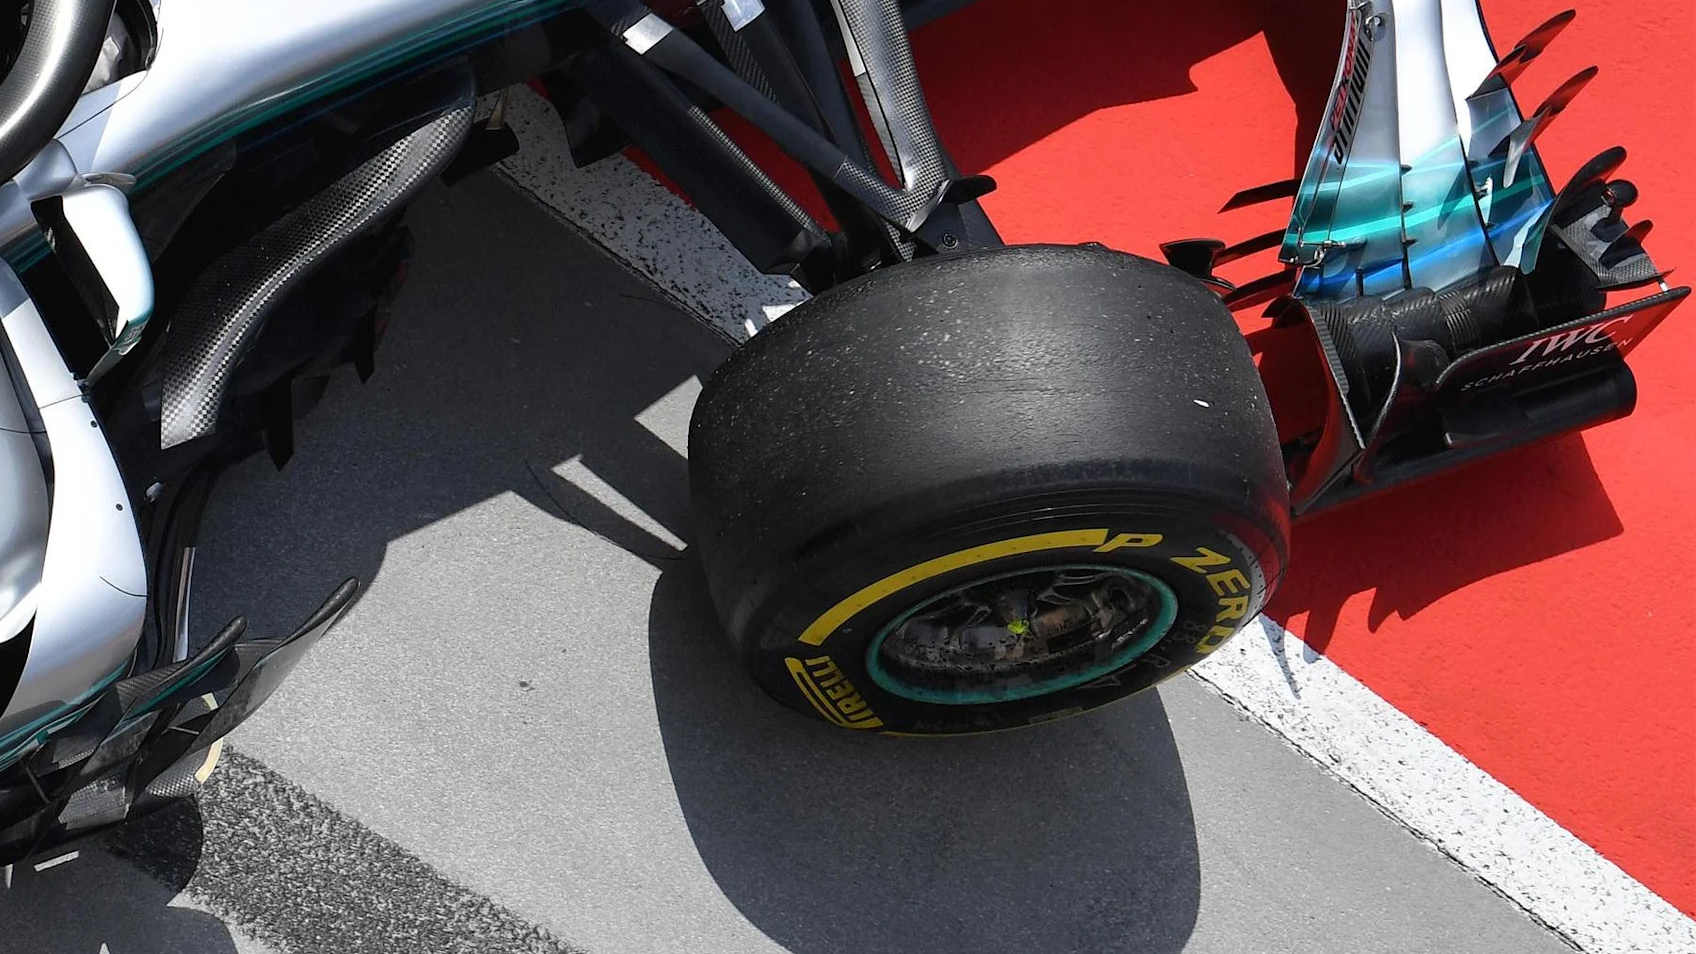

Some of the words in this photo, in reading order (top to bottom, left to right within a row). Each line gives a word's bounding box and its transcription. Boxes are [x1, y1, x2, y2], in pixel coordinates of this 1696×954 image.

[1461, 338, 1633, 391] SCHAFFHAUSEN
[1509, 314, 1634, 366] IWC
[1170, 547, 1250, 654] ZERO
[784, 655, 884, 730] PIRELLI
